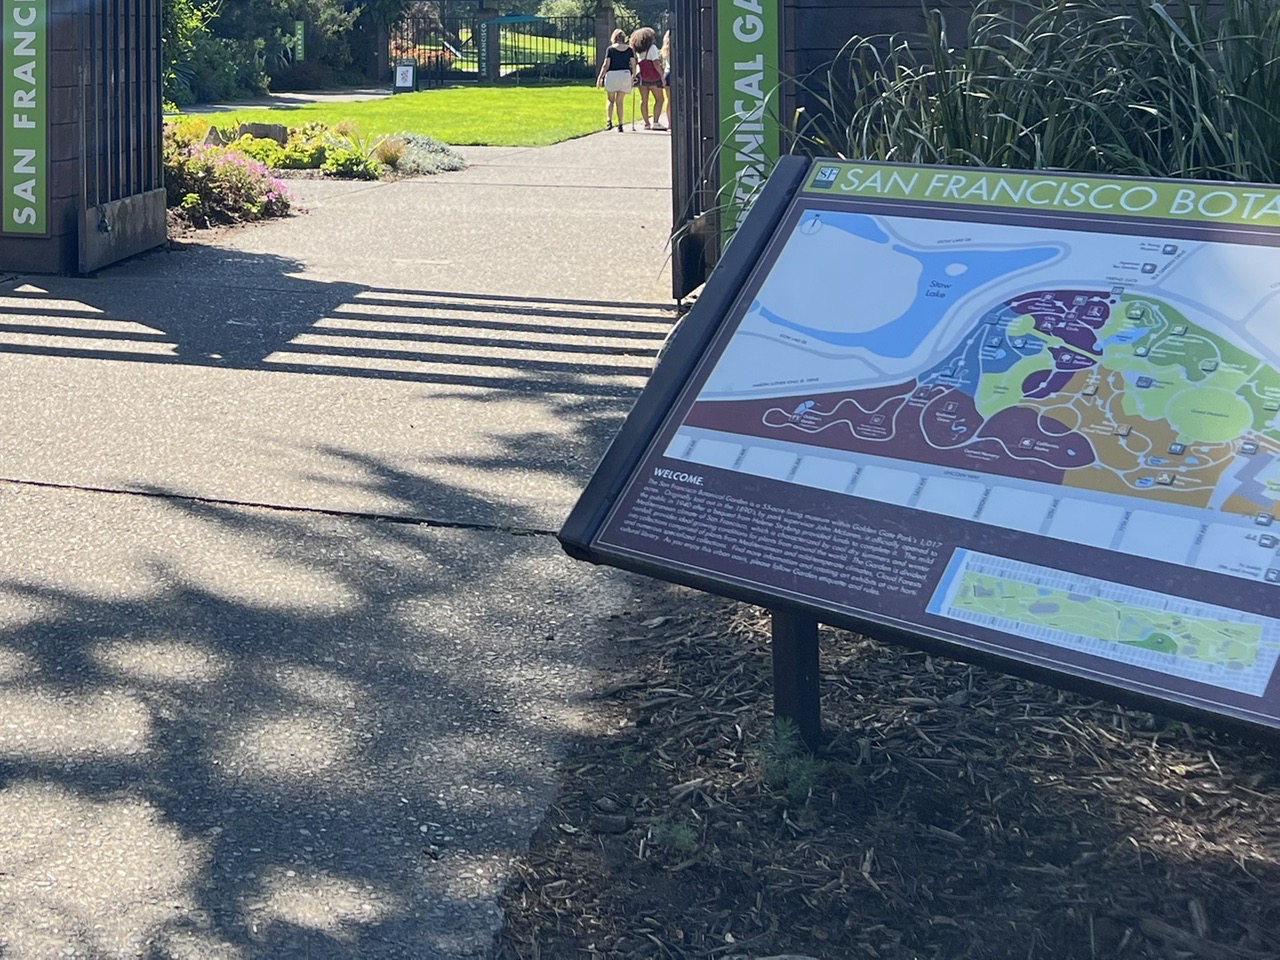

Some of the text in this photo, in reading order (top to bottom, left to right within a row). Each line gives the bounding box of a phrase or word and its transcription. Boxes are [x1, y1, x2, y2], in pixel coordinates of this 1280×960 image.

[734, 54, 765, 230] TANICAL
[12, 149, 37, 226] SAN
[840, 168, 1280, 220] SAN FRANCISCO BOTA
[925, 290, 946, 299] Lake
[929, 280, 952, 290] Stow
[654, 467, 704, 486] WELCOME.
